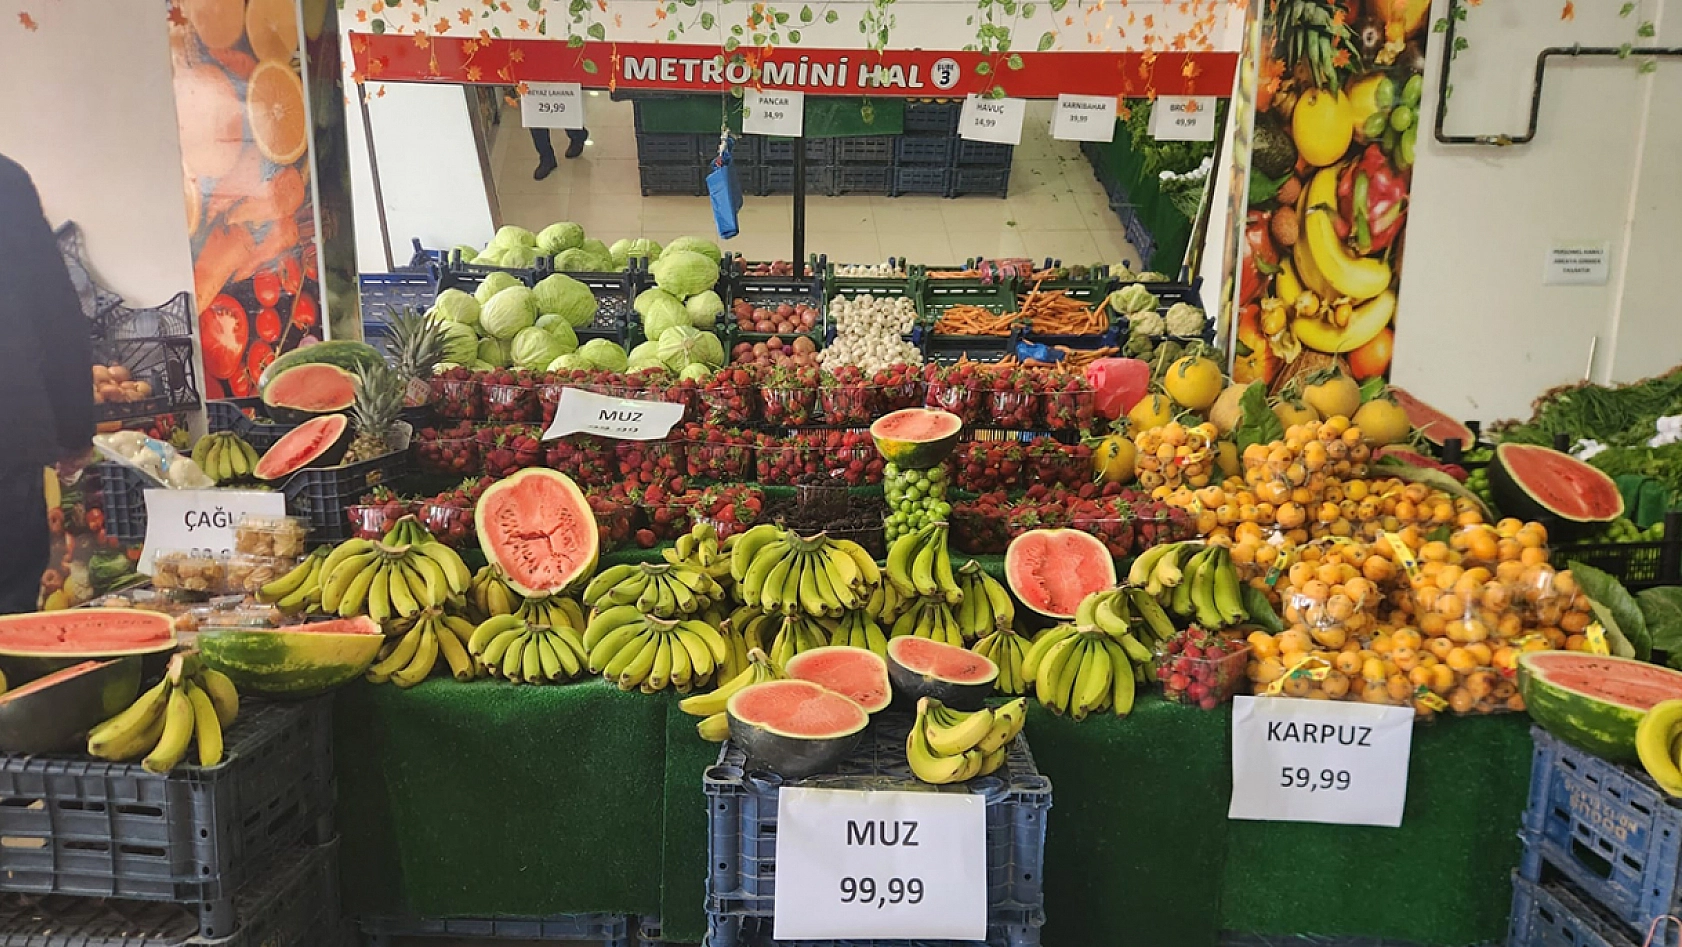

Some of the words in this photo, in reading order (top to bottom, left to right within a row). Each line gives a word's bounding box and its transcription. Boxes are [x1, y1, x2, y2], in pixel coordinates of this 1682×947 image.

[623, 57, 751, 85] METRO
[762, 56, 849, 88] MİNİ
[857, 64, 924, 88] HAL
[940, 71, 950, 85] 3
[538, 102, 566, 113] 29,99
[759, 97, 789, 105] PANCAR
[976, 103, 1004, 114] HAVUÇ
[974, 117, 997, 127] 14,99
[598, 409, 643, 422] MUZ
[1266, 721, 1373, 747] KARPUZ
[1280, 767, 1351, 792] 59,99
[847, 820, 919, 847] MUZ
[840, 877, 925, 909] 99,99
